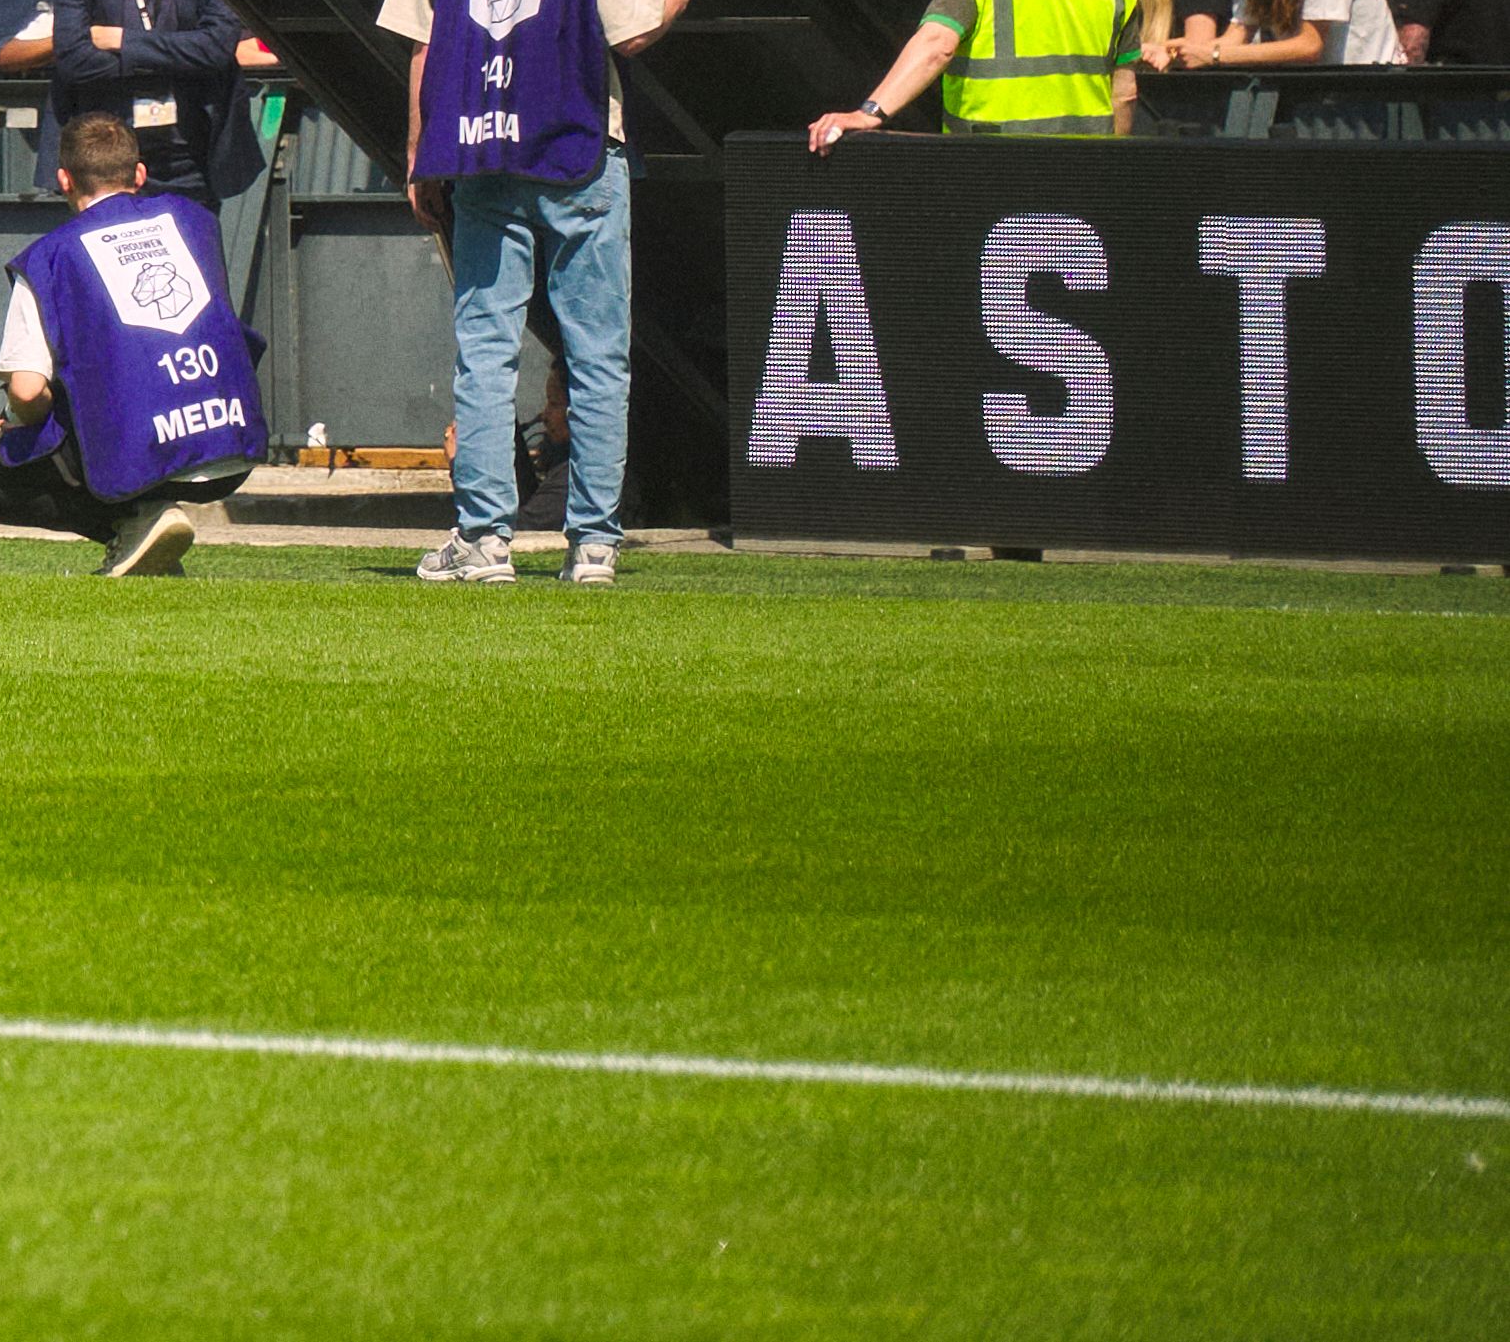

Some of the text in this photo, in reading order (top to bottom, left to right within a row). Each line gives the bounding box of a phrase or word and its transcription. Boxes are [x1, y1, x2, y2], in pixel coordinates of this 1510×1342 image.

[114, 238, 164, 255] VROUWEN
[118, 247, 171, 266] EREDIVISIE
[158, 344, 219, 384] 130
[745, 208, 1510, 491] ASTO
